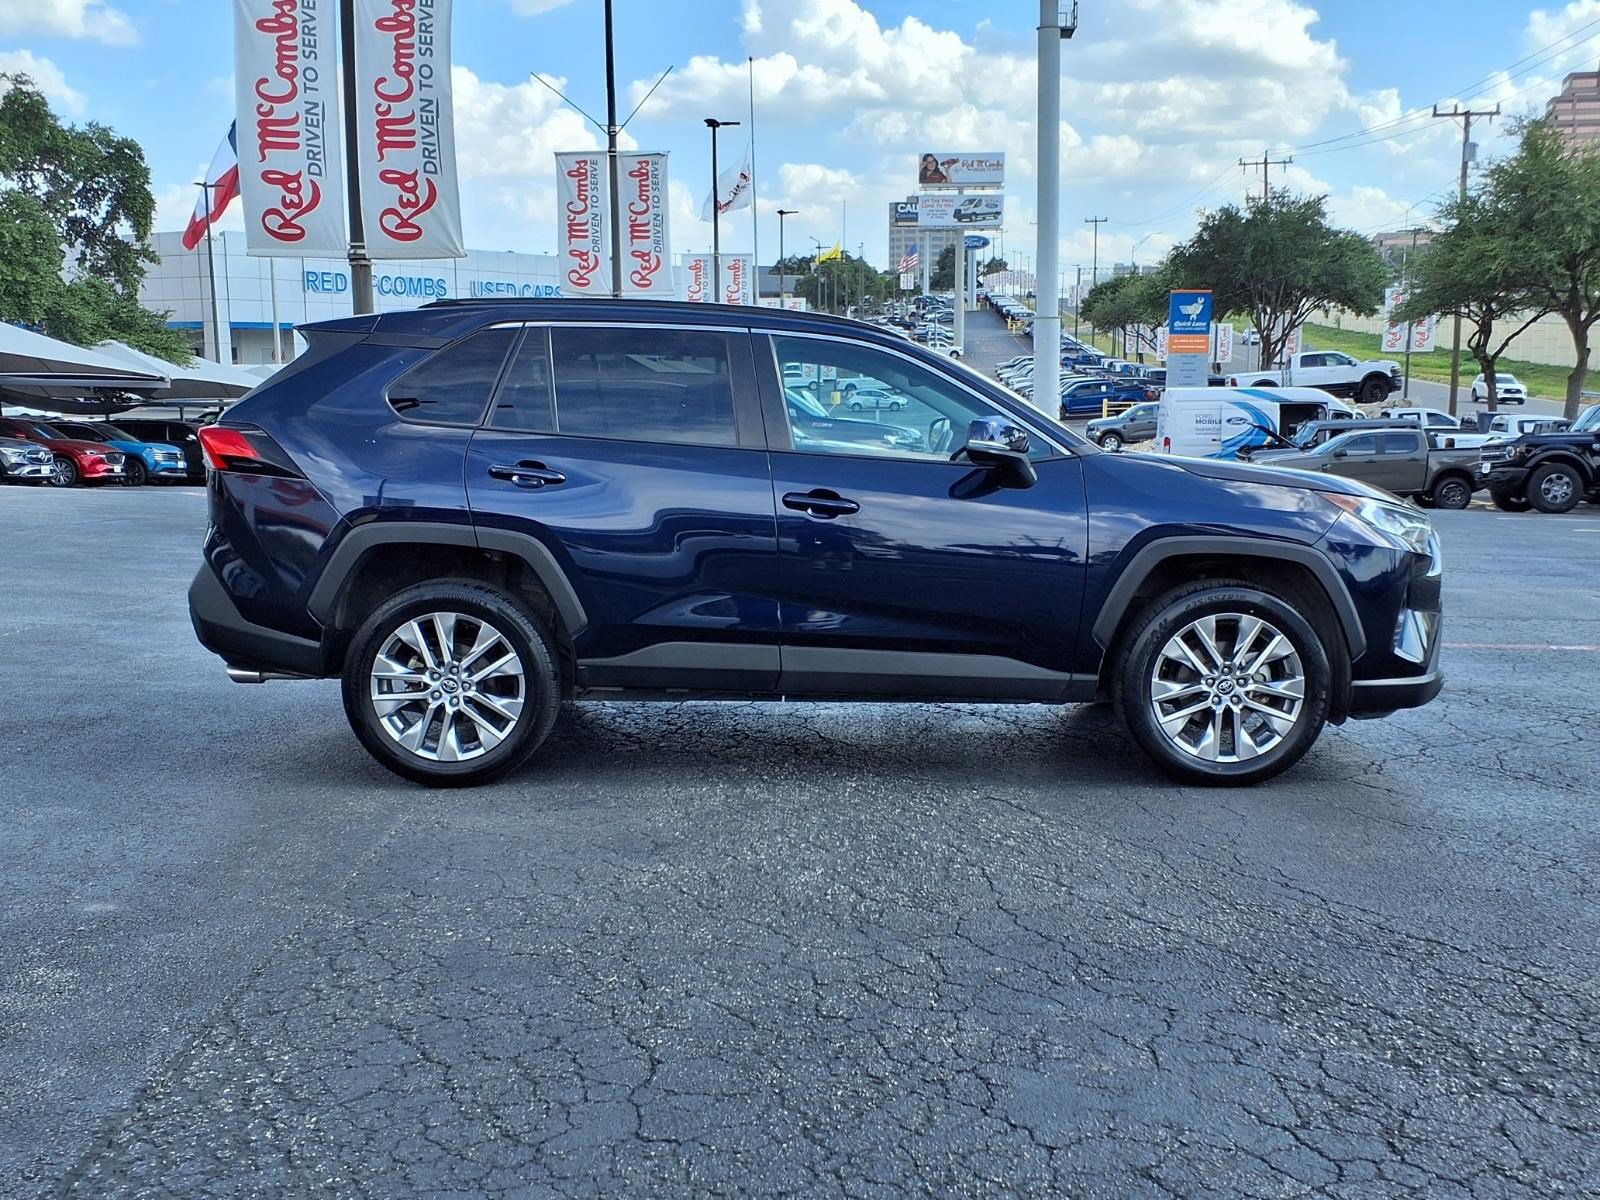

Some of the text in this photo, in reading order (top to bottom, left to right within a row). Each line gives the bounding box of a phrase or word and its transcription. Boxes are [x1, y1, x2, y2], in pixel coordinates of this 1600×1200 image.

[255, 0, 321, 242] Red McCombs
[302, 0, 323, 177] DRIVEN TO SERVE
[374, 0, 437, 242] Red McCombs
[415, 0, 438, 176] DRIVEN TO SERVE
[566, 159, 600, 288] Red McCombs
[590, 159, 601, 253] DRIVEN TO SERVE
[628, 160, 661, 288] Red McCombs
[651, 160, 662, 254] DRIVEN TO SERVE
[305, 271, 348, 293] RED
[471, 281, 517, 297] USED
